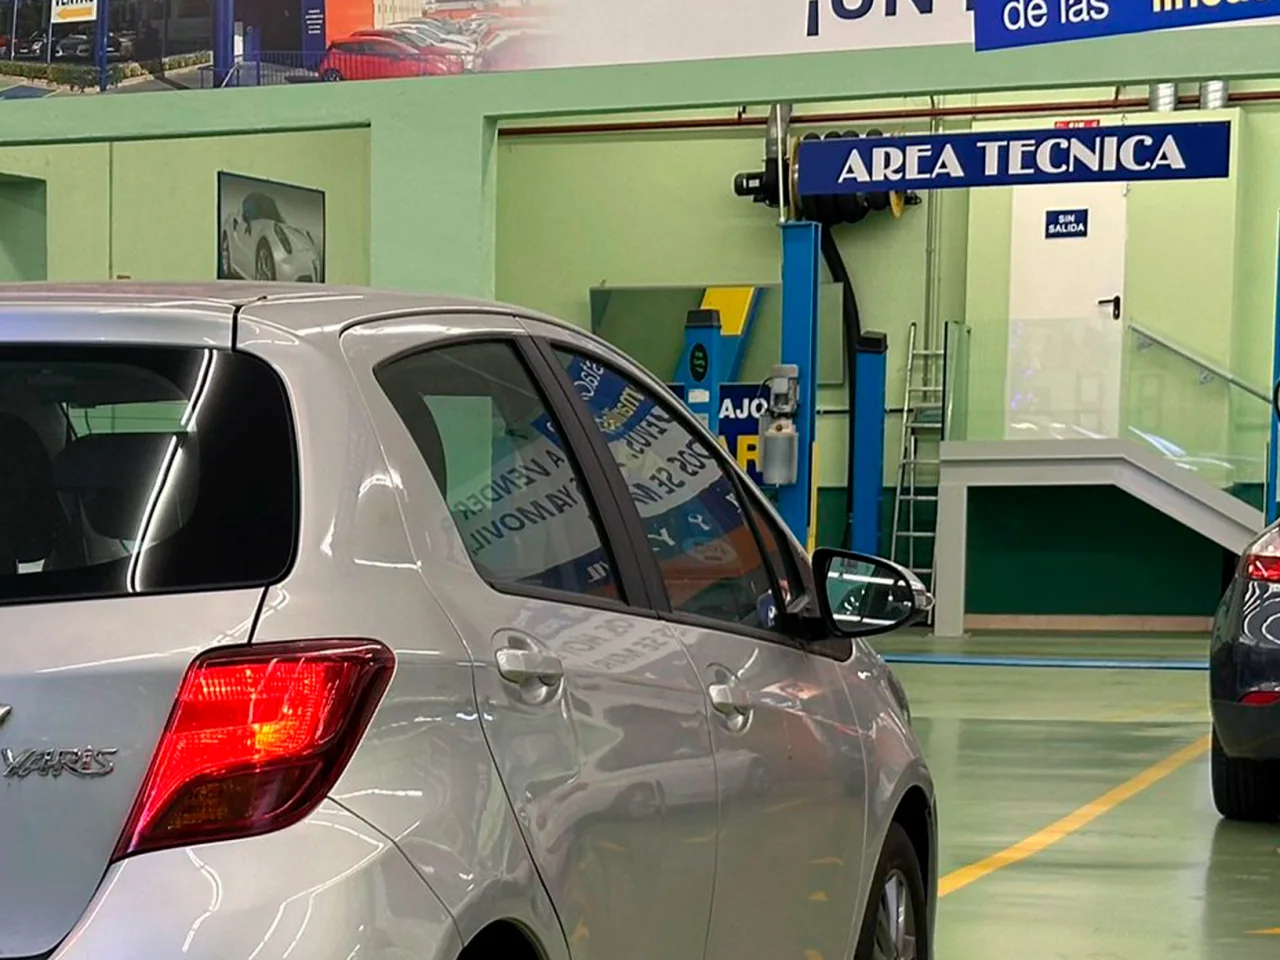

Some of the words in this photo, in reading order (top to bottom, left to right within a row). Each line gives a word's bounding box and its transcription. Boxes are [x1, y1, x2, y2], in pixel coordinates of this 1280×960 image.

[838, 142, 964, 183] AREA
[976, 134, 1186, 175] TECNICA
[1048, 223, 1085, 234] SALIDA
[1058, 214, 1076, 224] SIN
[718, 398, 769, 420] AJO
[0, 747, 119, 779] YARIS
